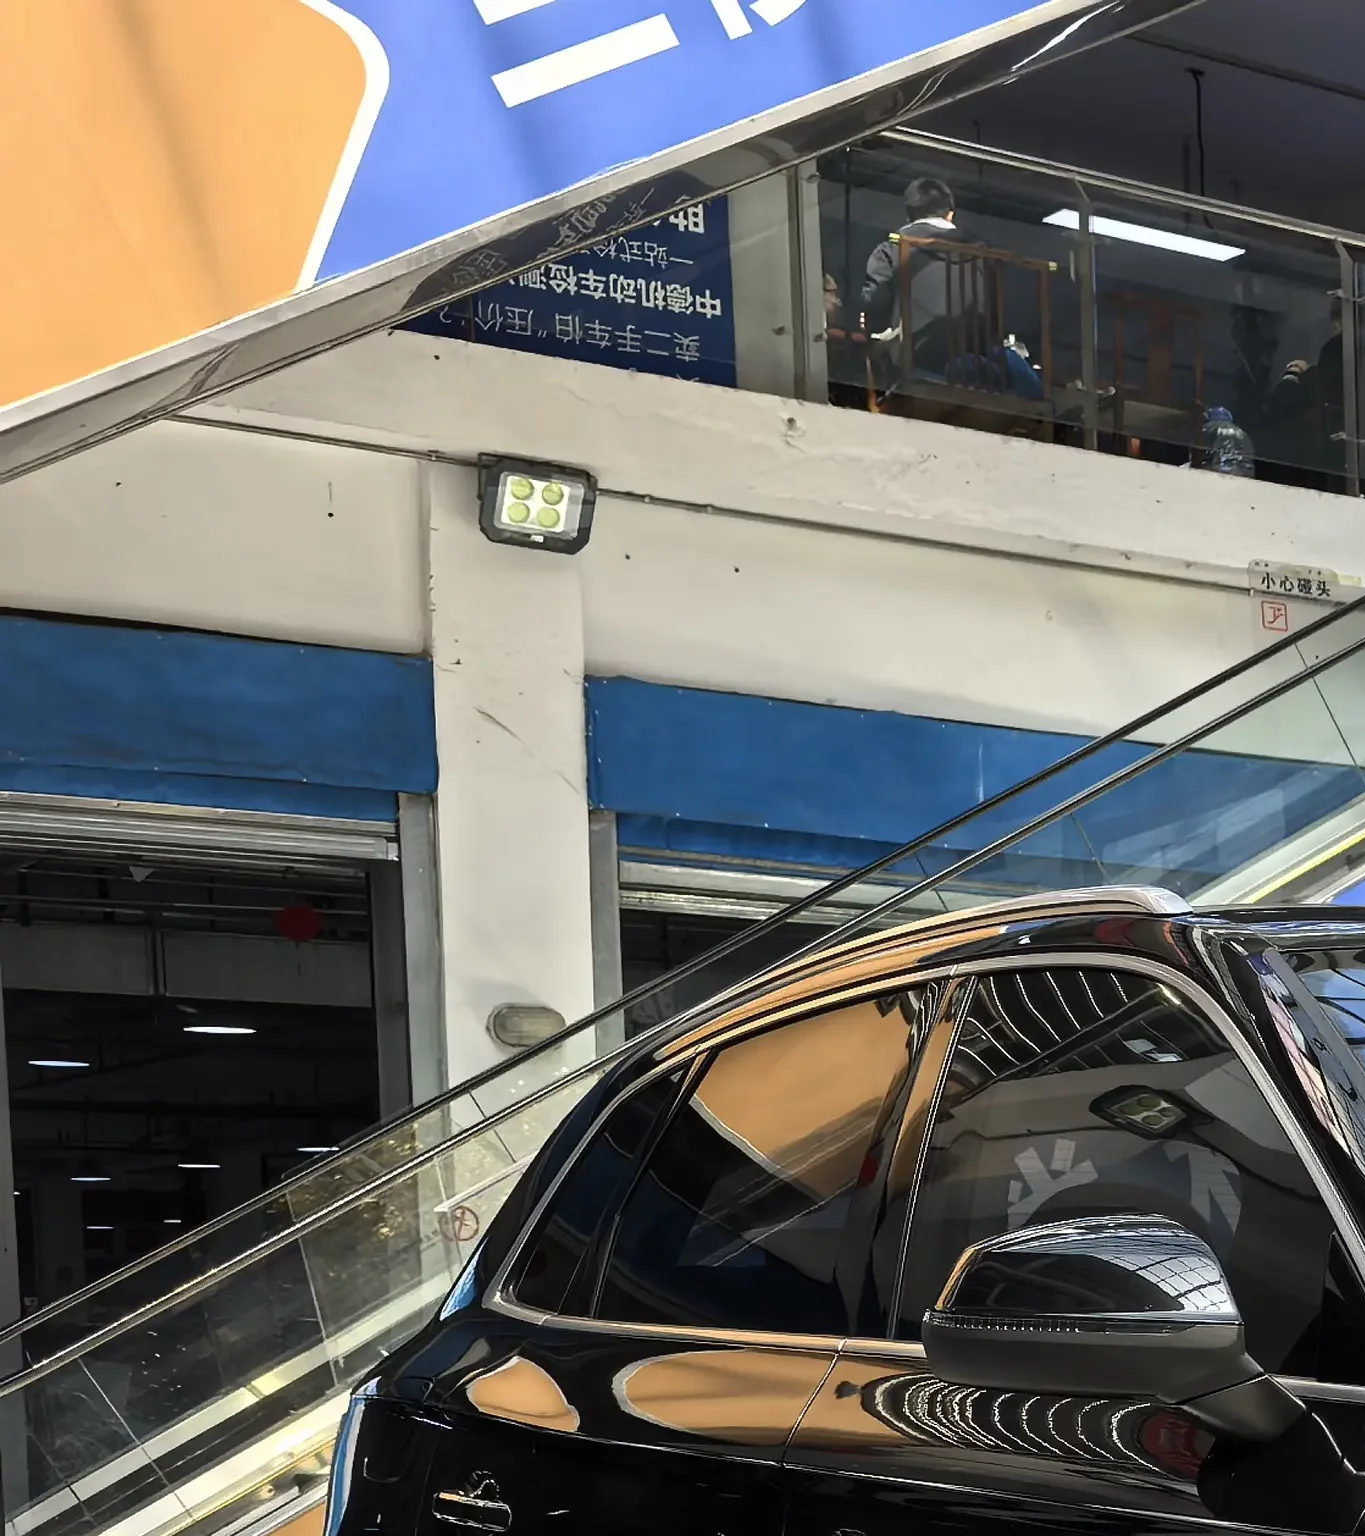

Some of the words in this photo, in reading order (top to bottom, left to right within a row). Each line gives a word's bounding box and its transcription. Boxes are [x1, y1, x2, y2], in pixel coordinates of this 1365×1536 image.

[508, 262, 721, 319] 中德机动车检测
[1261, 571, 1332, 597] 小心碰头
